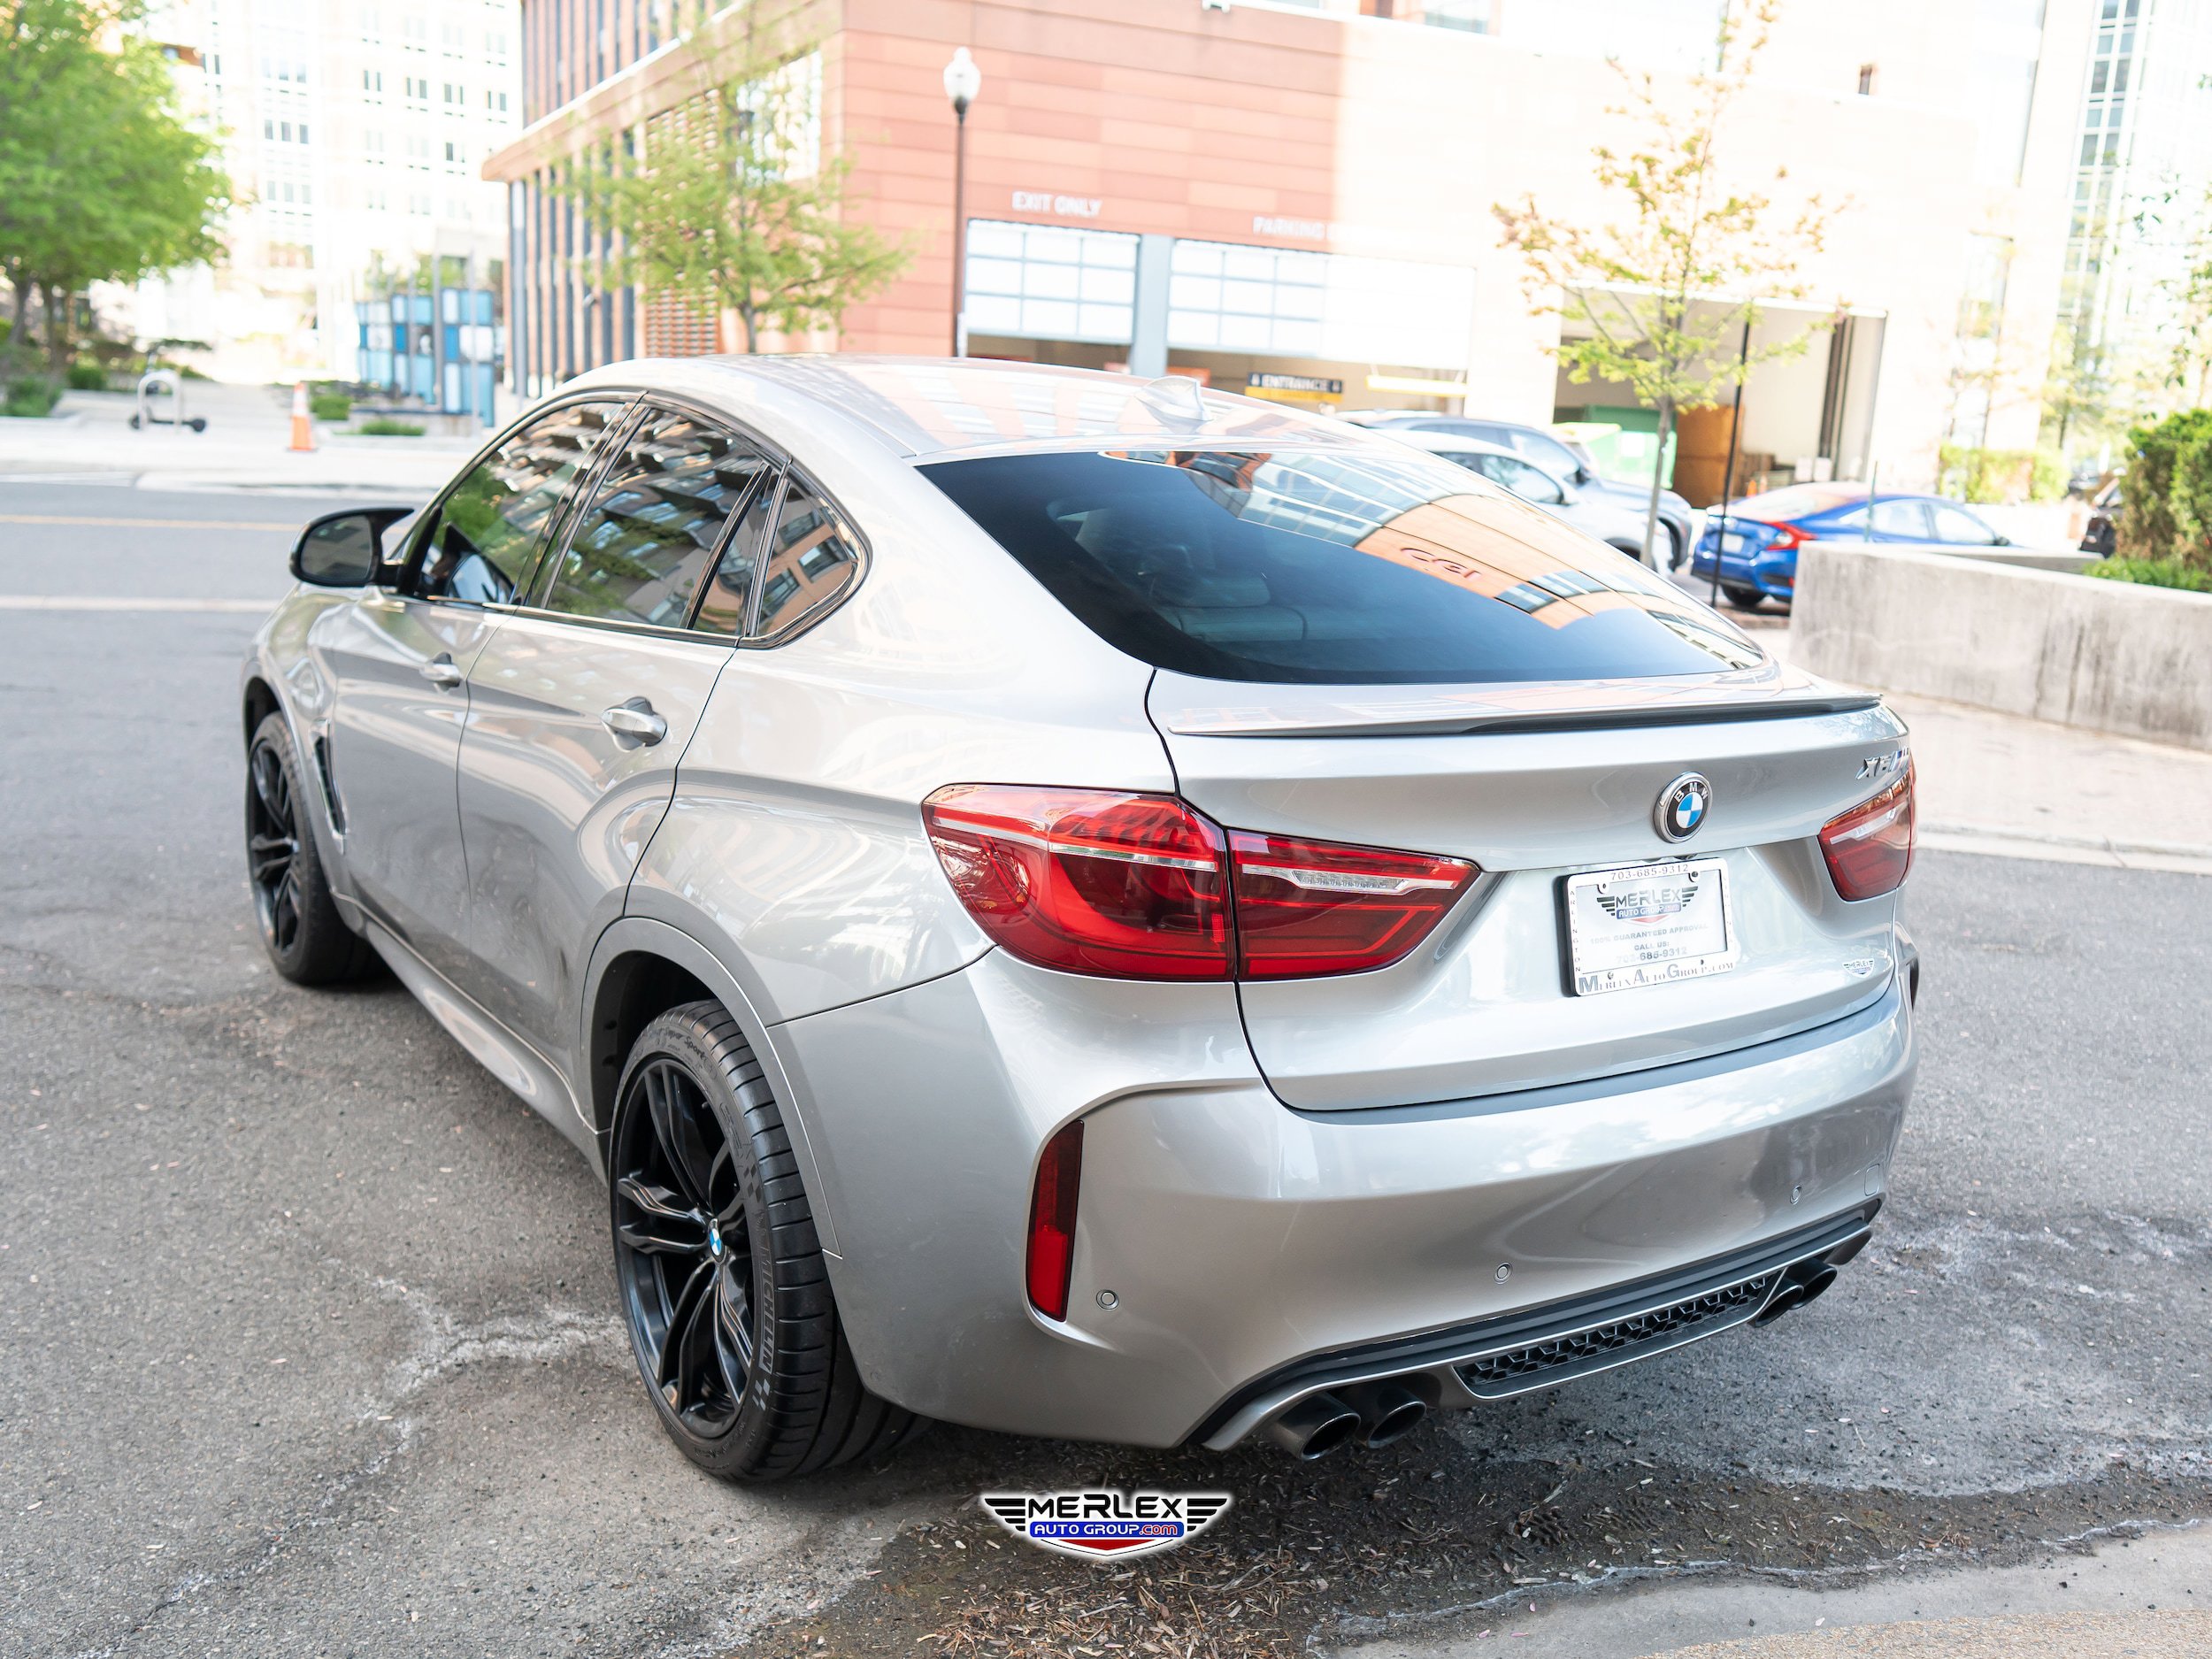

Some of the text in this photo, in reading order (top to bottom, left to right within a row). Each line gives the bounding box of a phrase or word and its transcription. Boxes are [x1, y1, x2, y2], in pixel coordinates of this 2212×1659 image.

[1011, 190, 1102, 218] EXIT ONLY
[1674, 782, 1709, 803] BMW
[1610, 864, 1688, 880] 703-685-9312
[1617, 888, 1681, 908] MERLEX
[1618, 907, 1640, 918] AUTO
[1634, 942, 1654, 951] CALL
[759, 1246, 774, 1371] MICHELIN
